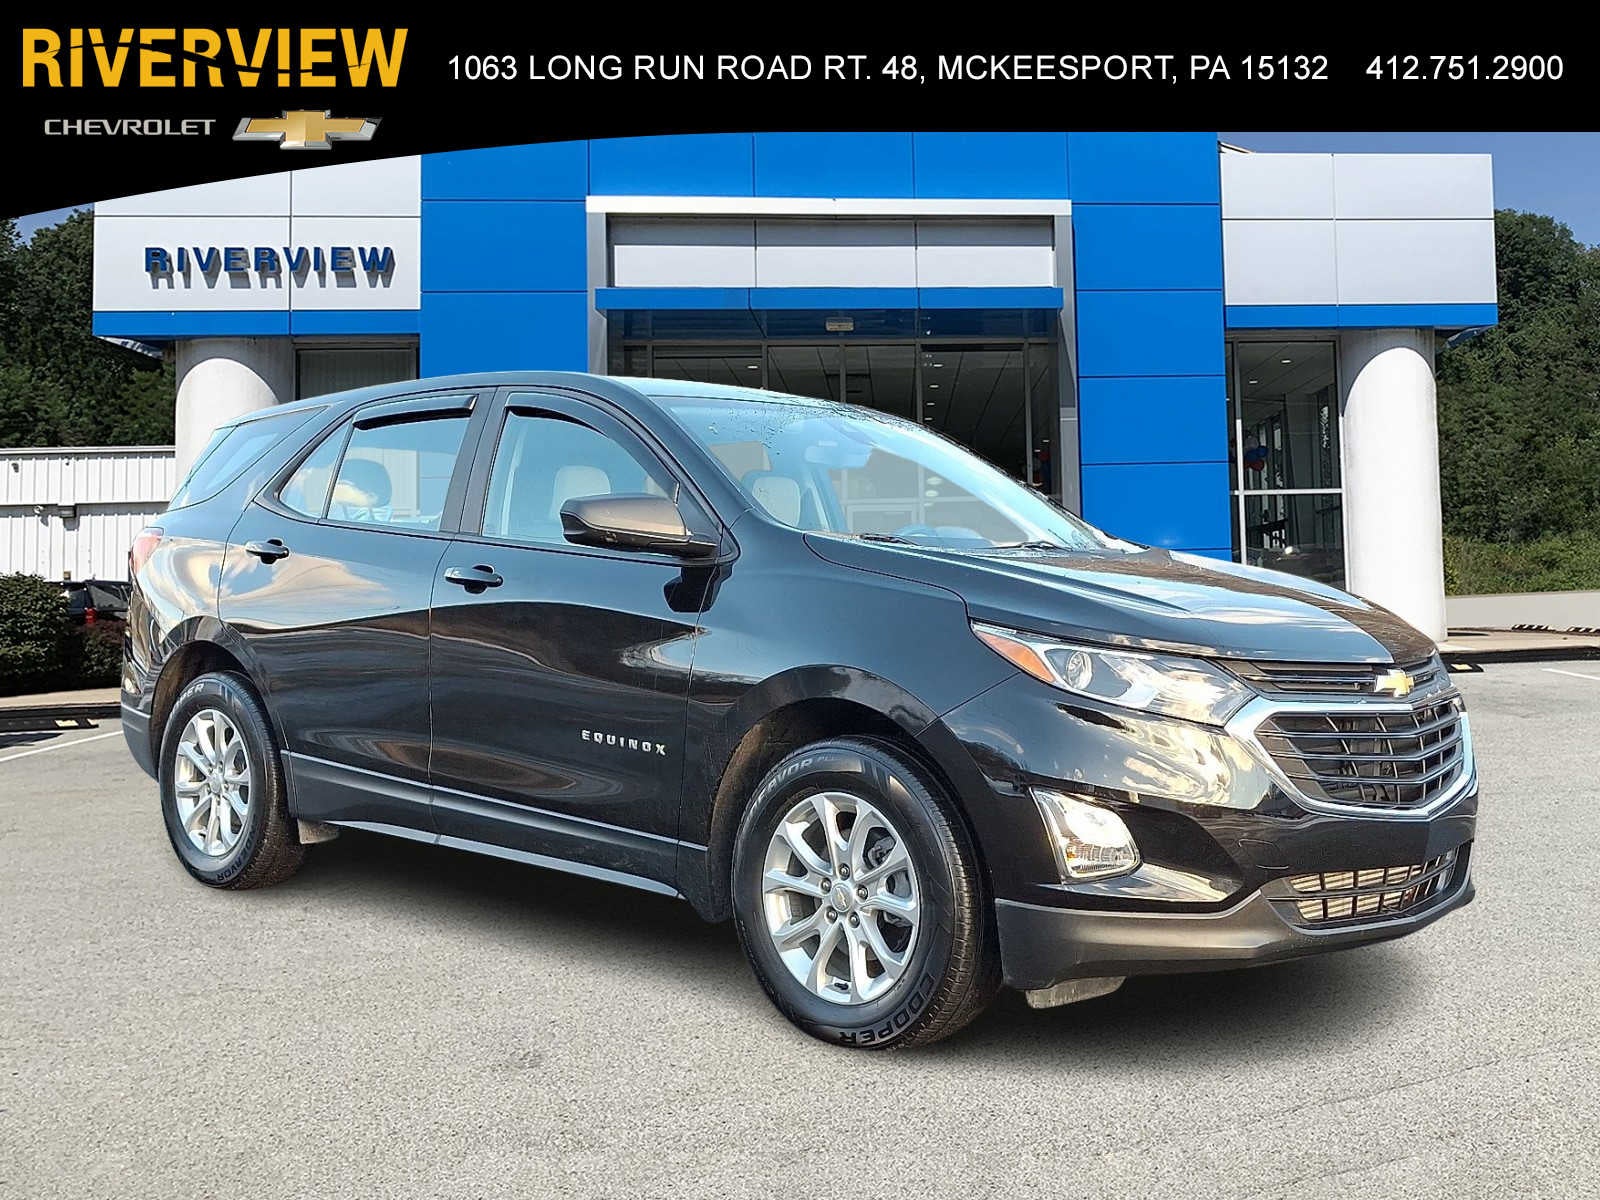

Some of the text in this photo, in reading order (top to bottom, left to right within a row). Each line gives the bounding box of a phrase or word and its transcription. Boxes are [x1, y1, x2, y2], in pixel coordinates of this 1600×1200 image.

[144, 246, 393, 276] RIVERVIEW
[580, 729, 667, 757] EQUINOX
[839, 972, 937, 1045] COOPER
